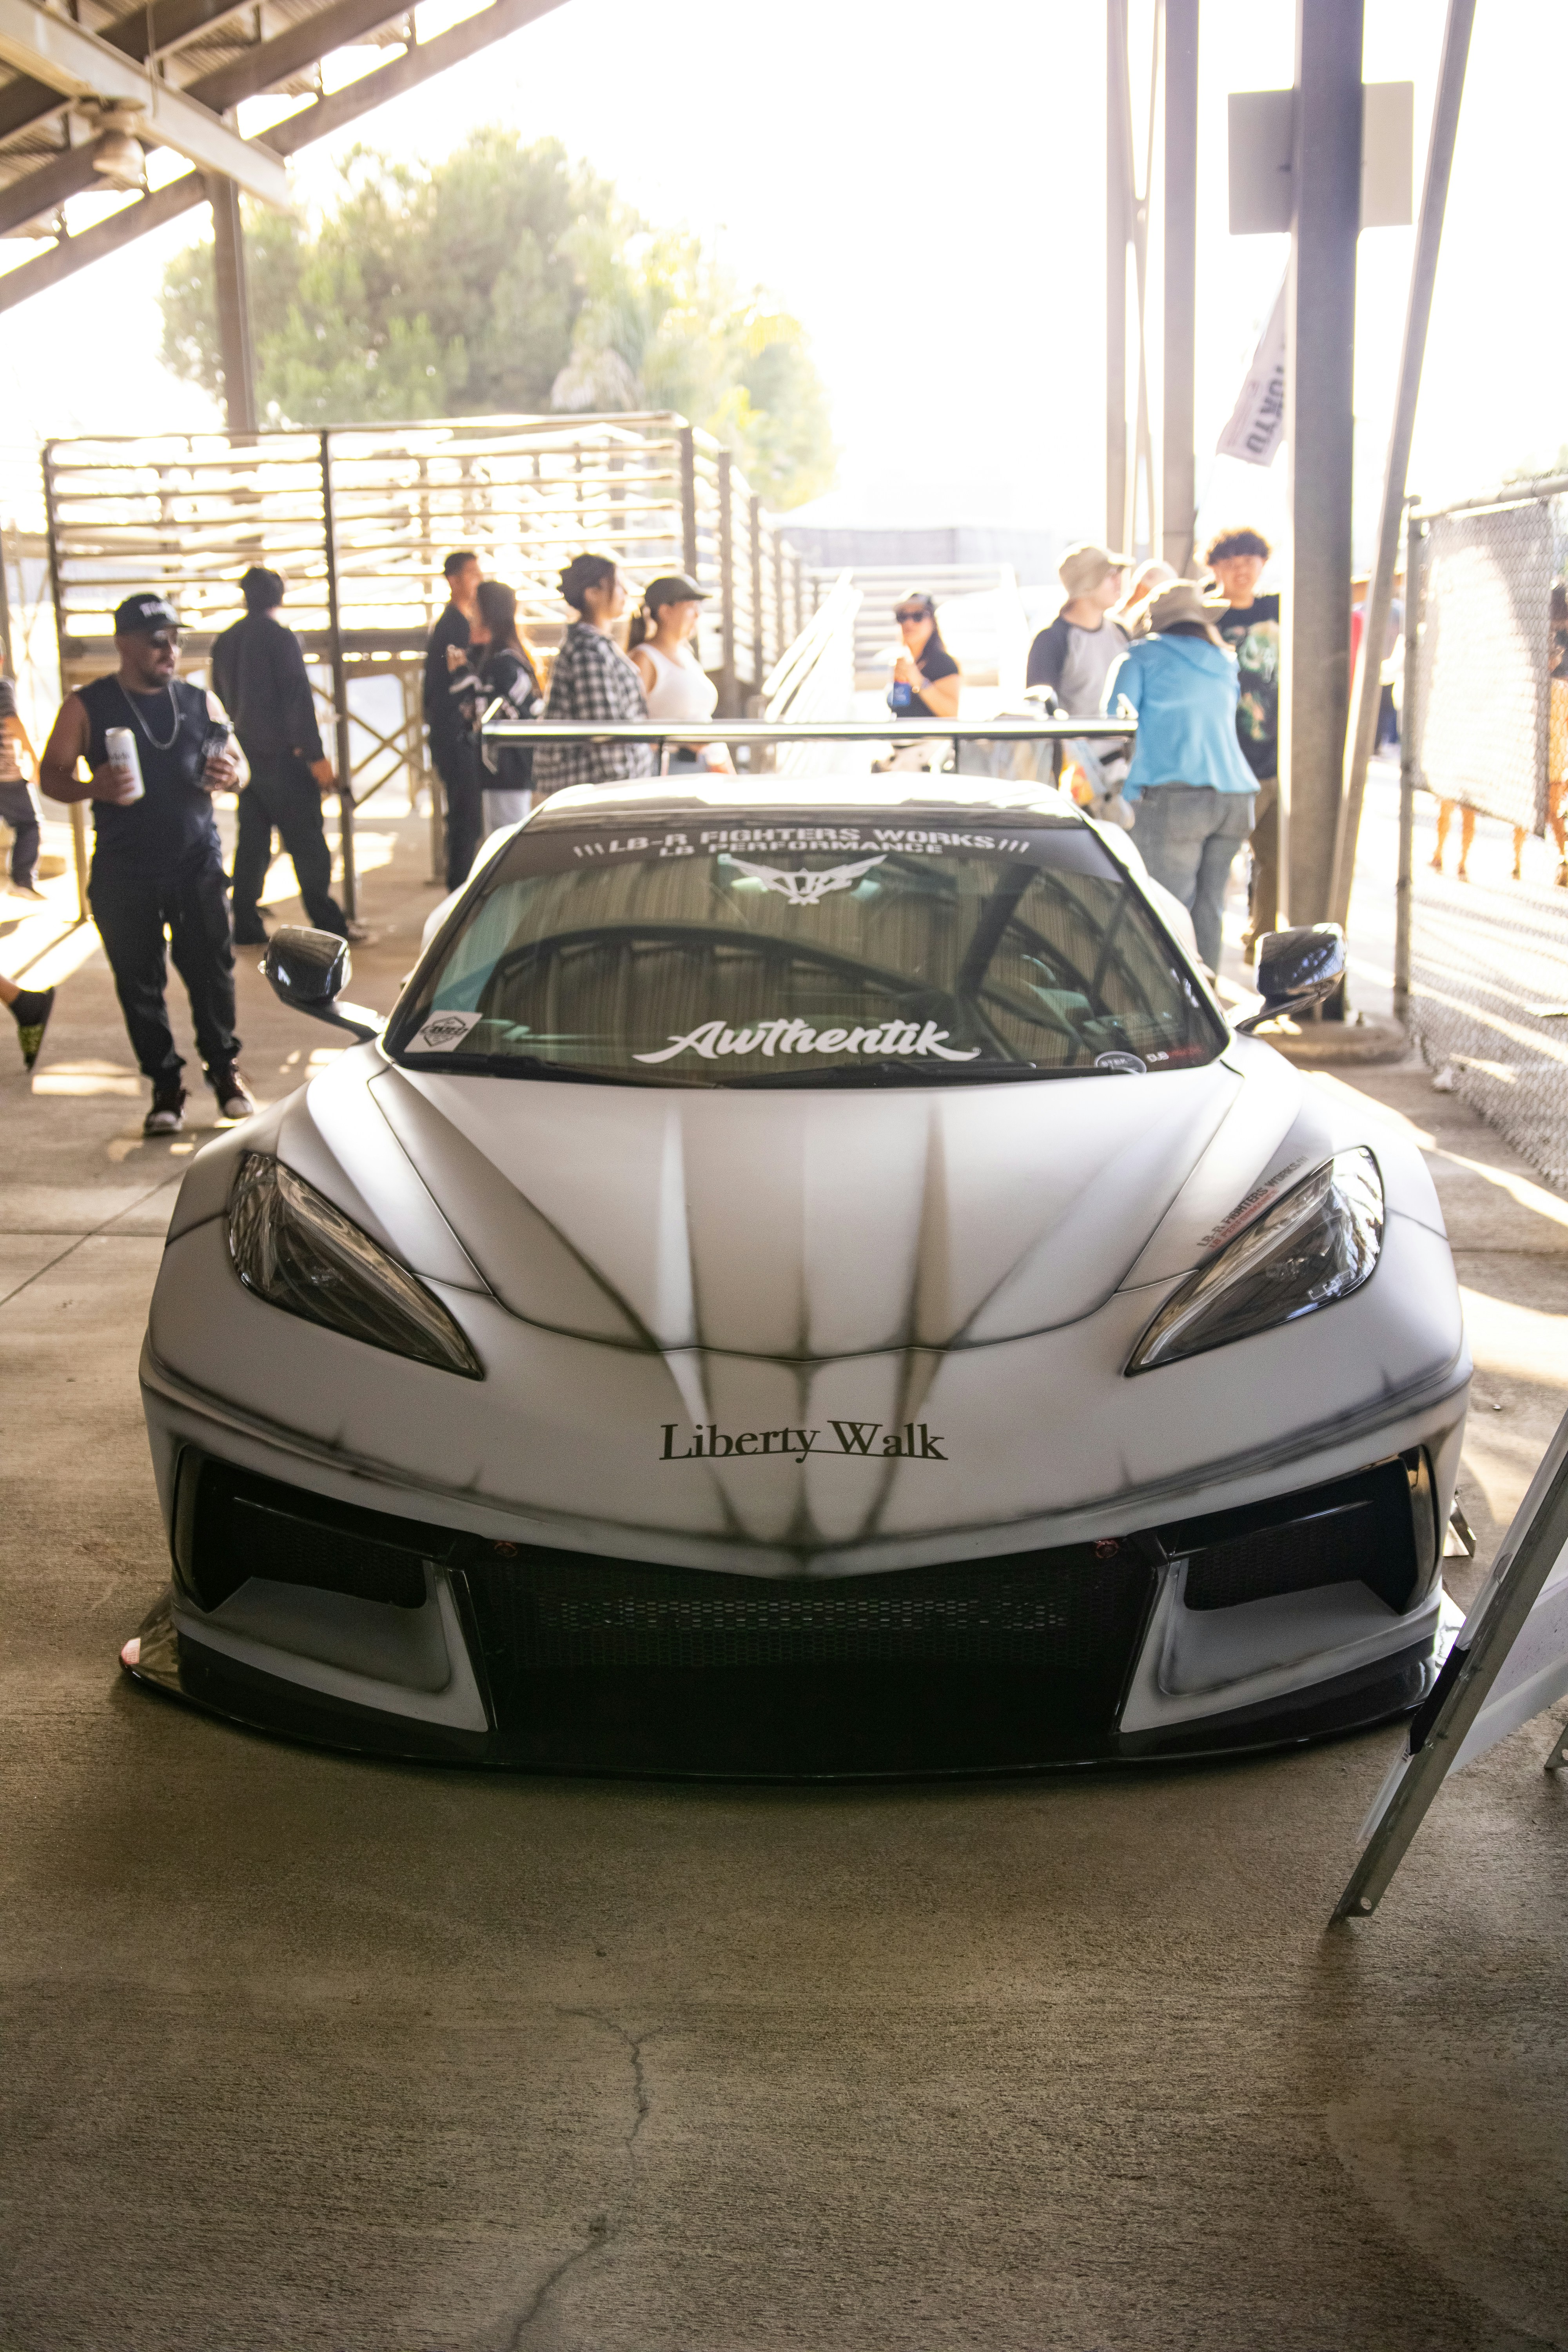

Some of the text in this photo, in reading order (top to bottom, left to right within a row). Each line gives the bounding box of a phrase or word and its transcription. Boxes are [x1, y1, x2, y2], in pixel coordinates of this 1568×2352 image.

[700, 828, 861, 844] FIGHTERS
[659, 840, 943, 857] LB PERFORMANCE
[659, 1420, 948, 1463] Liberty Walk
